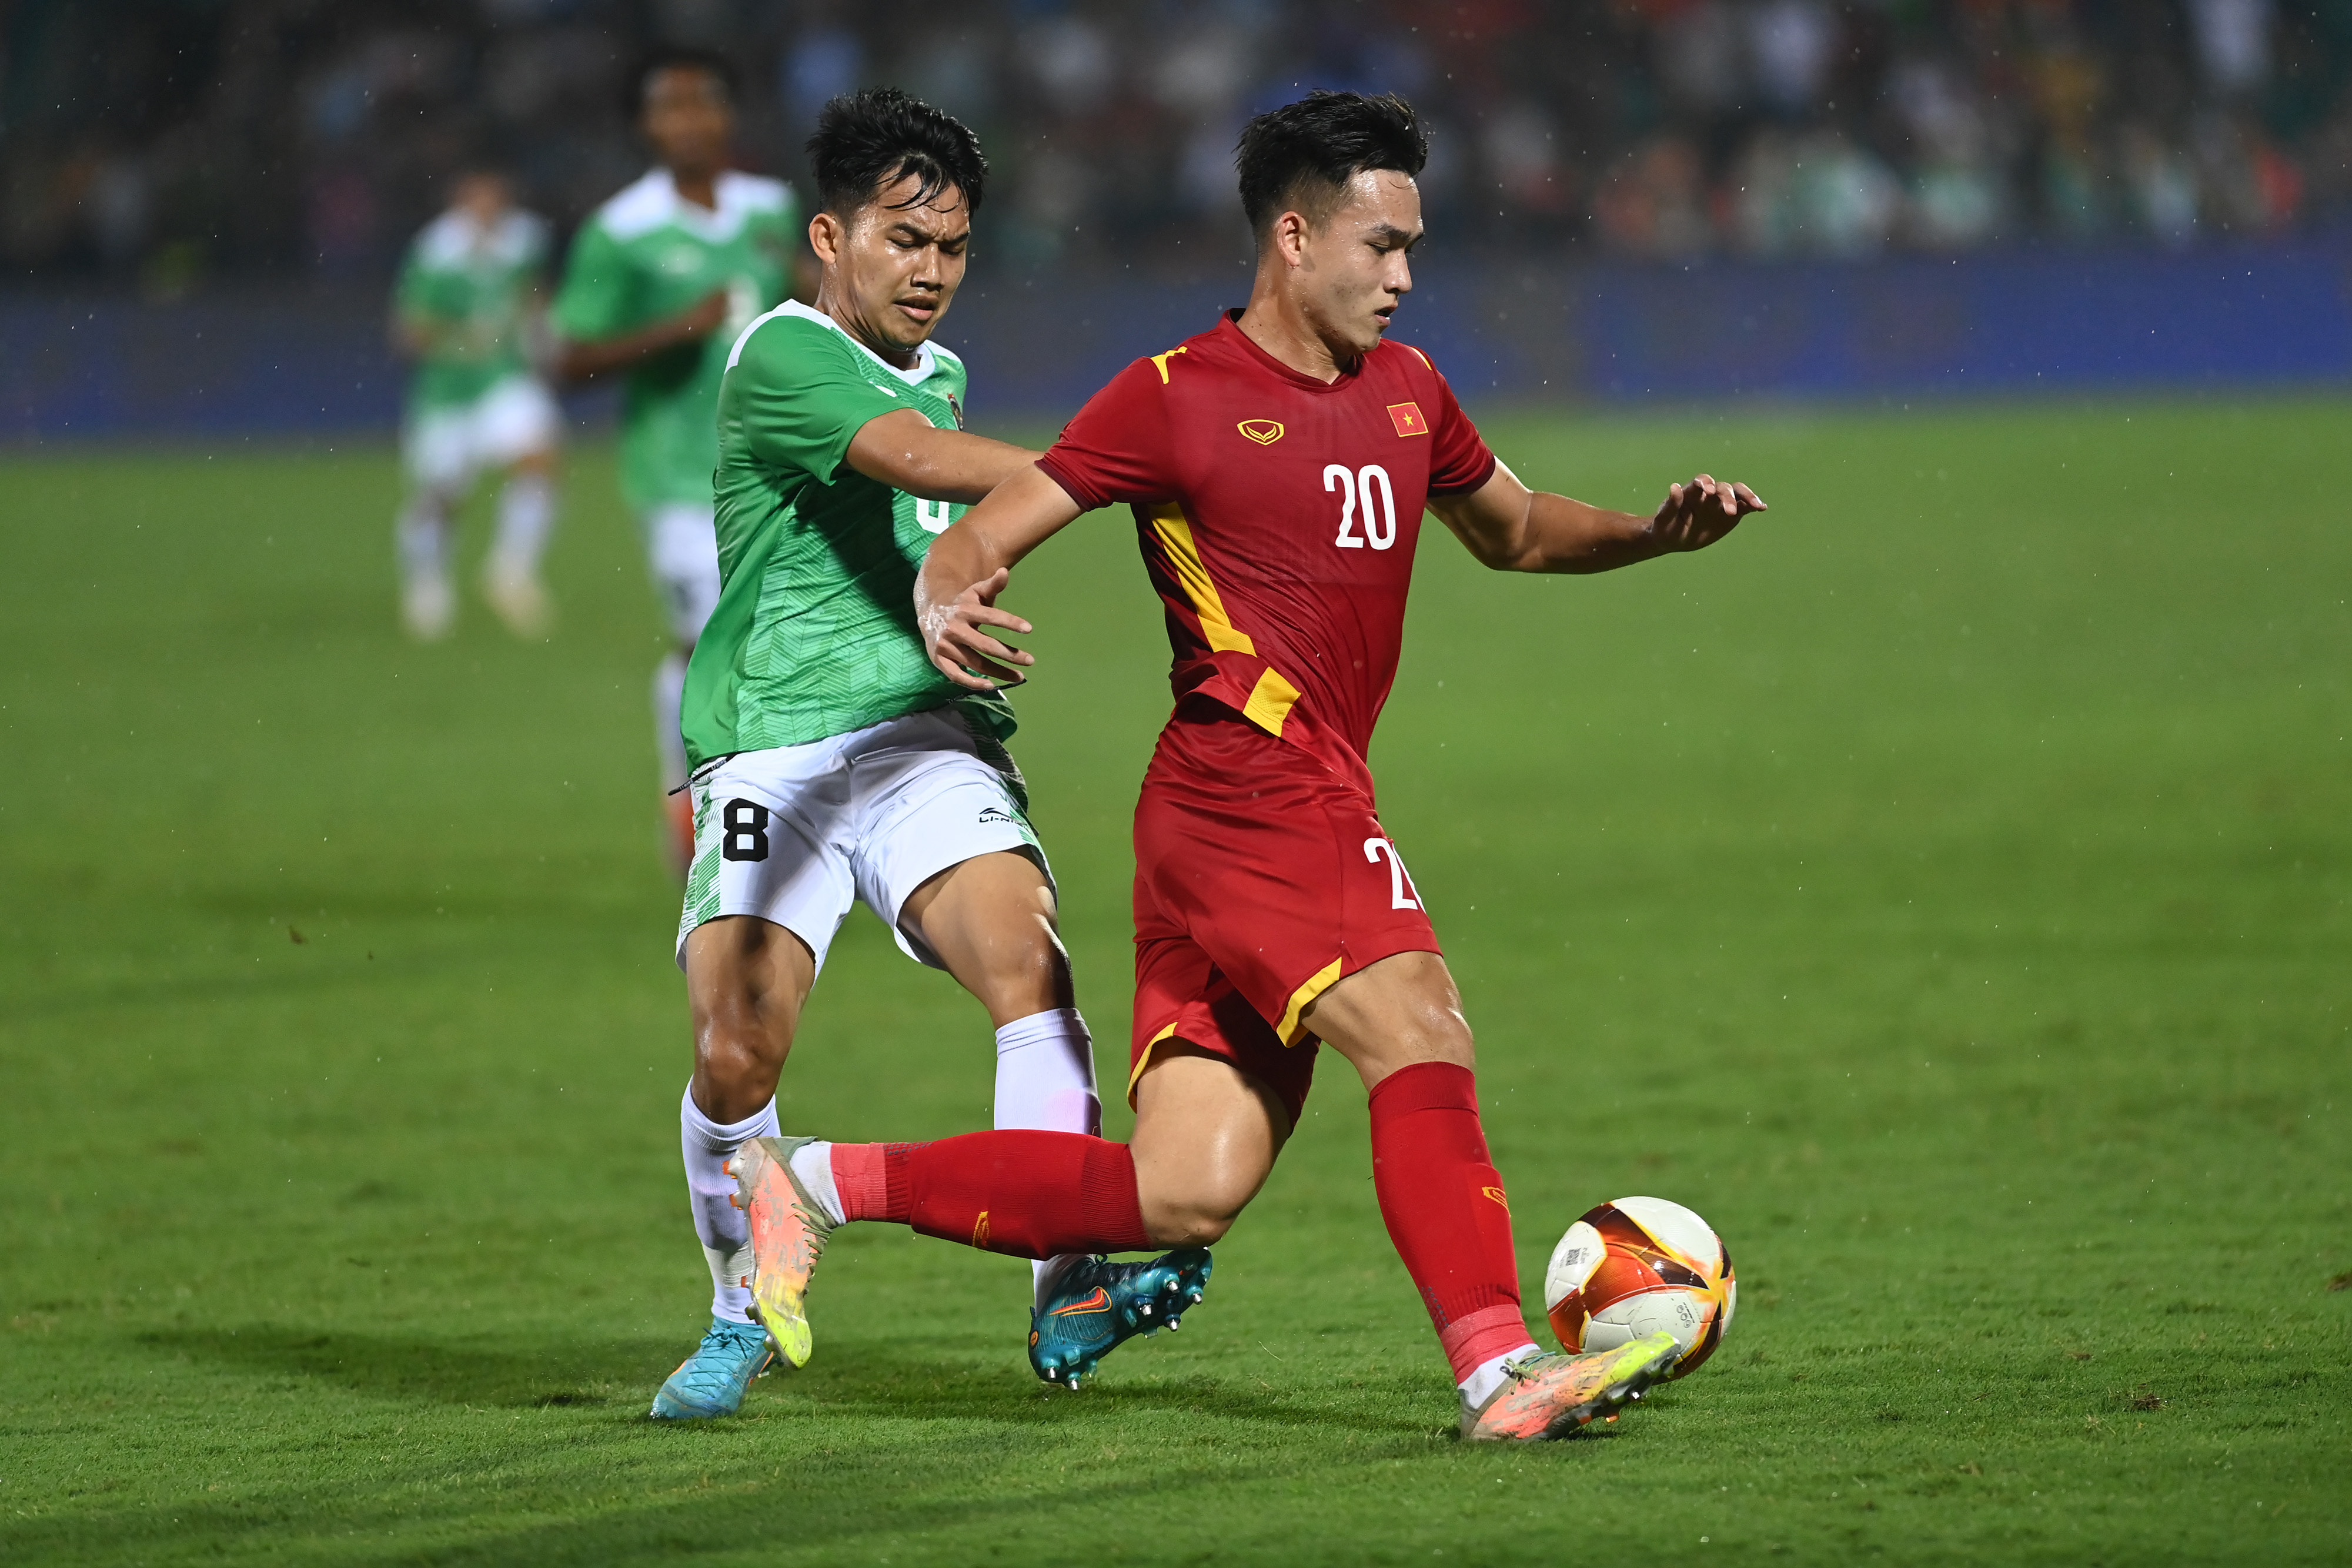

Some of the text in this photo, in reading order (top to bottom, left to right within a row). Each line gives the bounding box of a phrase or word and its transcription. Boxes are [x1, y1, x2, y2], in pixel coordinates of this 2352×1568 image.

[1323, 464, 1396, 550] 20
[723, 797, 769, 862] 8
[1364, 837, 1426, 914] 2
